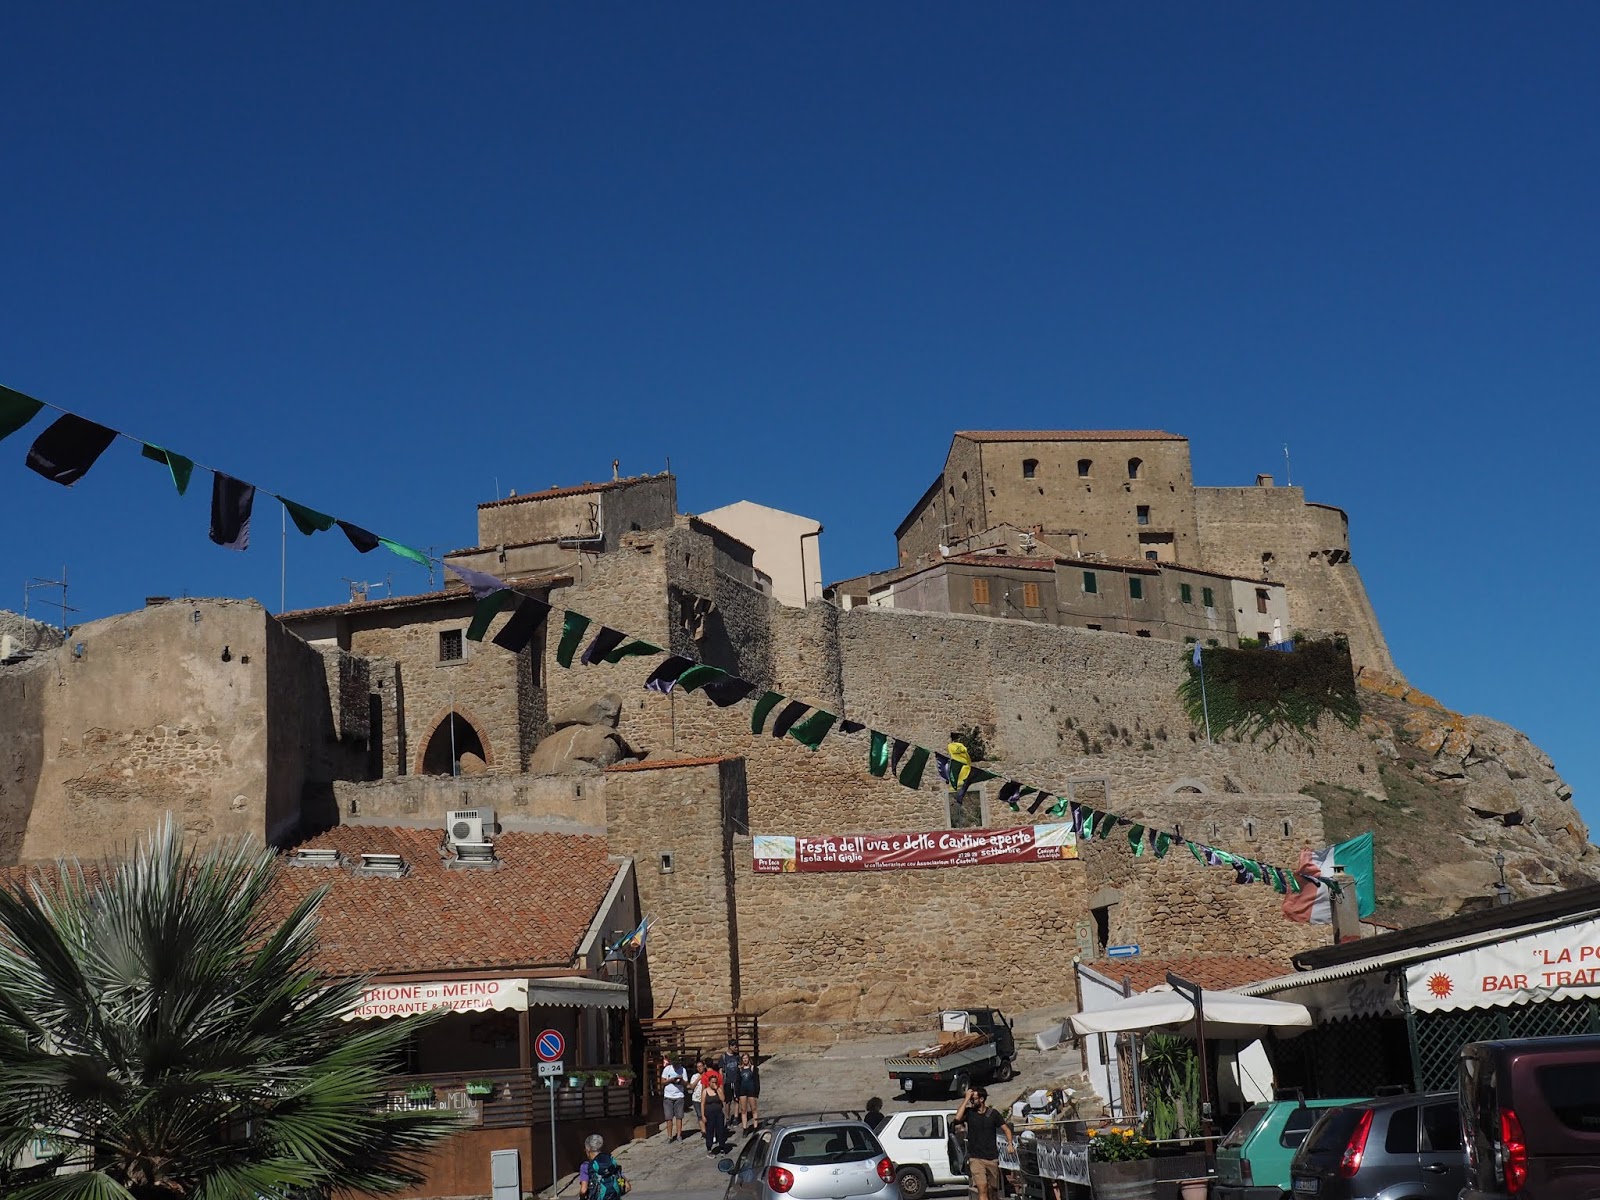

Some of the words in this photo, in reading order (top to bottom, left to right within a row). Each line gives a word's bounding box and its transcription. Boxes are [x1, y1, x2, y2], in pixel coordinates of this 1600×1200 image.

[800, 838, 837, 854] Festa
[892, 842, 900, 851] e
[903, 834, 935, 850] delle
[939, 834, 986, 849] Cantine
[989, 831, 1031, 849] aperte
[800, 854, 822, 863] Isola
[823, 853, 836, 862] del
[839, 852, 863, 863] Giglio
[980, 846, 1021, 857] settembre
[916, 859, 949, 867] Associazione
[955, 857, 978, 865] Castello
[443, 982, 499, 997] MEINO
[1482, 974, 1528, 992] BAR
[354, 1002, 427, 1015] RISTORANTE
[431, 1003, 438, 1011] &
[442, 998, 493, 1010] PIZZERIA
